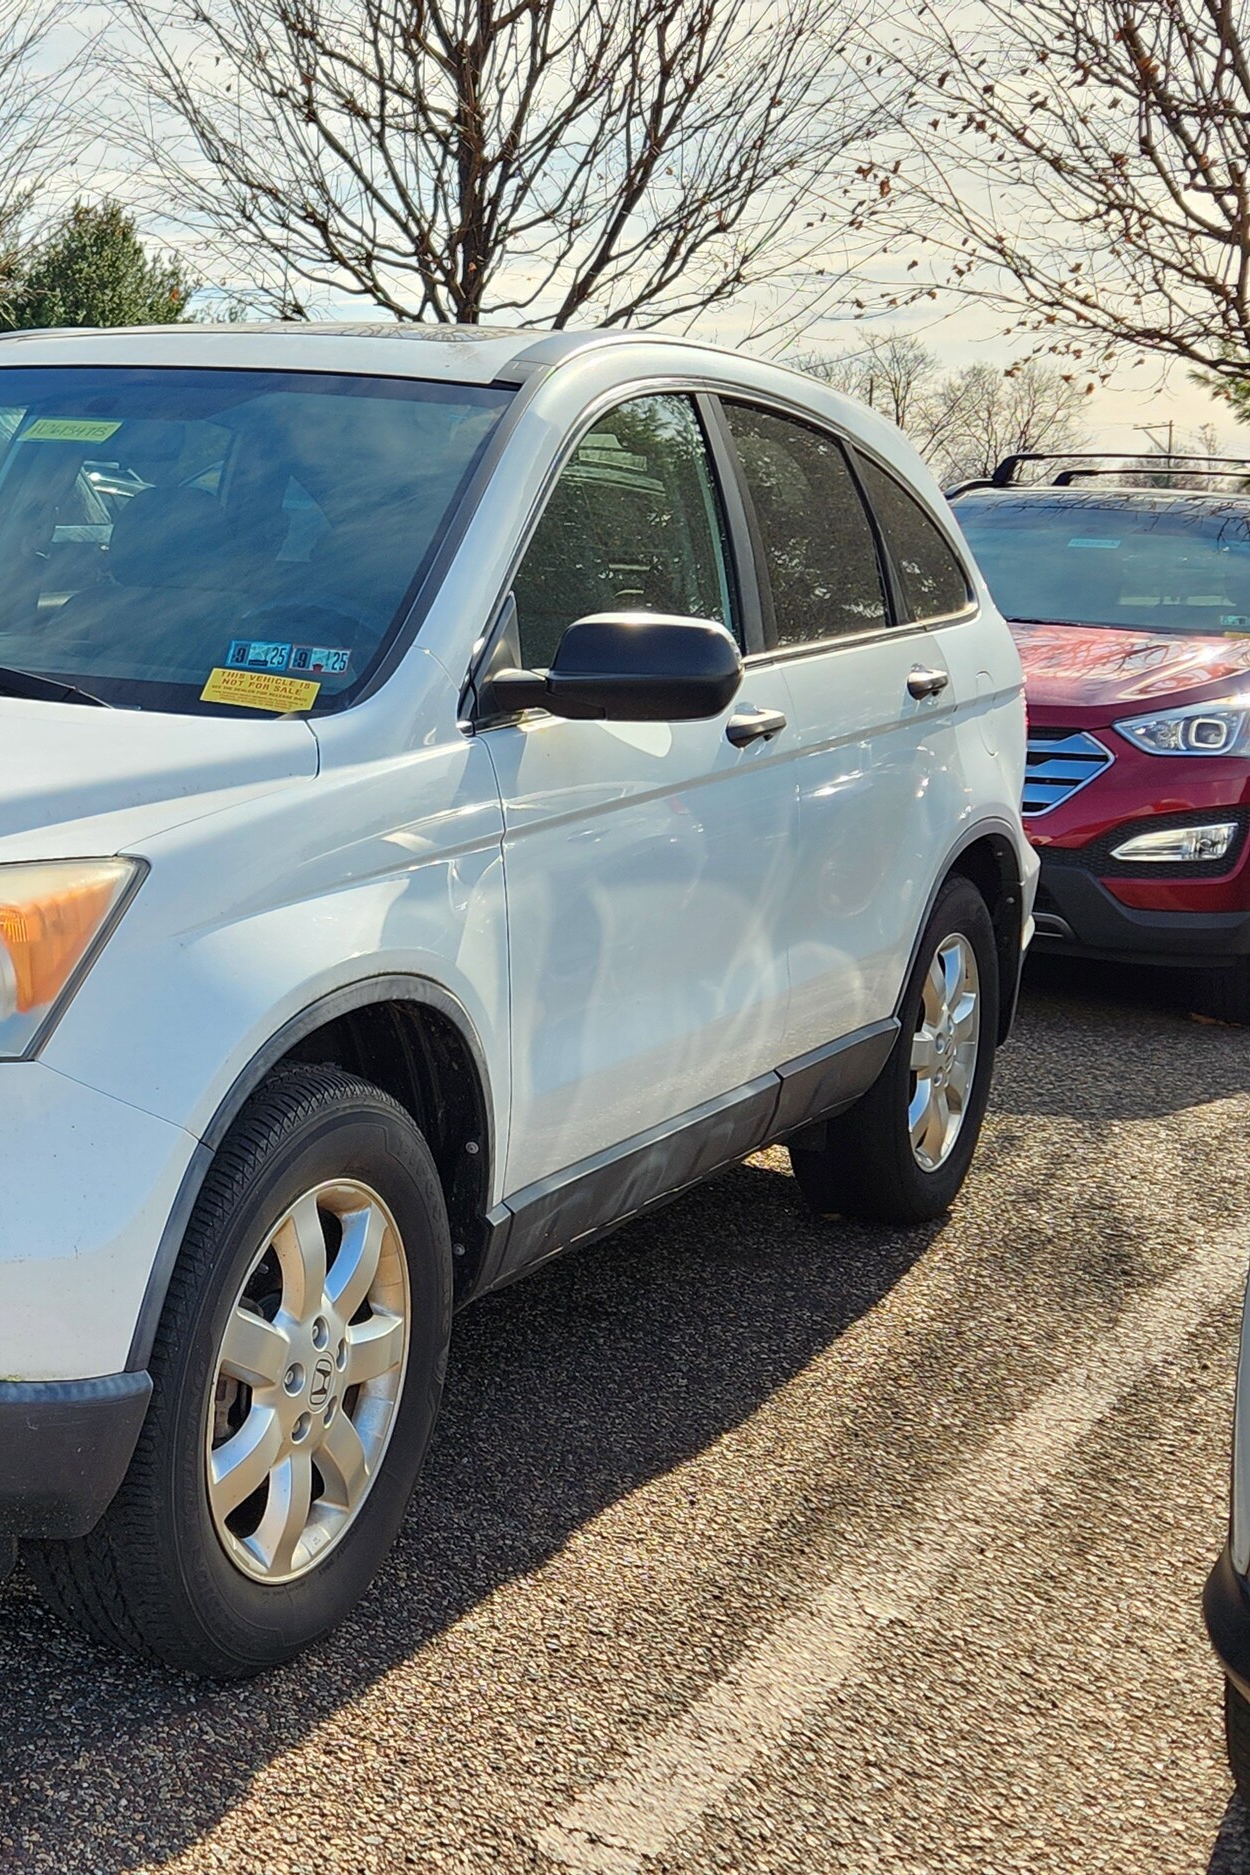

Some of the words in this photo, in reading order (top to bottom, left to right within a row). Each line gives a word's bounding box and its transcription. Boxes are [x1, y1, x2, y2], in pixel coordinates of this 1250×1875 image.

[235, 647, 246, 664] 9
[269, 646, 287, 666] 25
[298, 648, 308, 669] 9
[331, 651, 348, 671] 25
[220, 670, 245, 680] THIS
[250, 674, 294, 687] VEHICLE
[299, 681, 311, 690] IS
[221, 678, 247, 688] NOT
[249, 681, 271, 691] FOR
[272, 685, 303, 696] SALE
